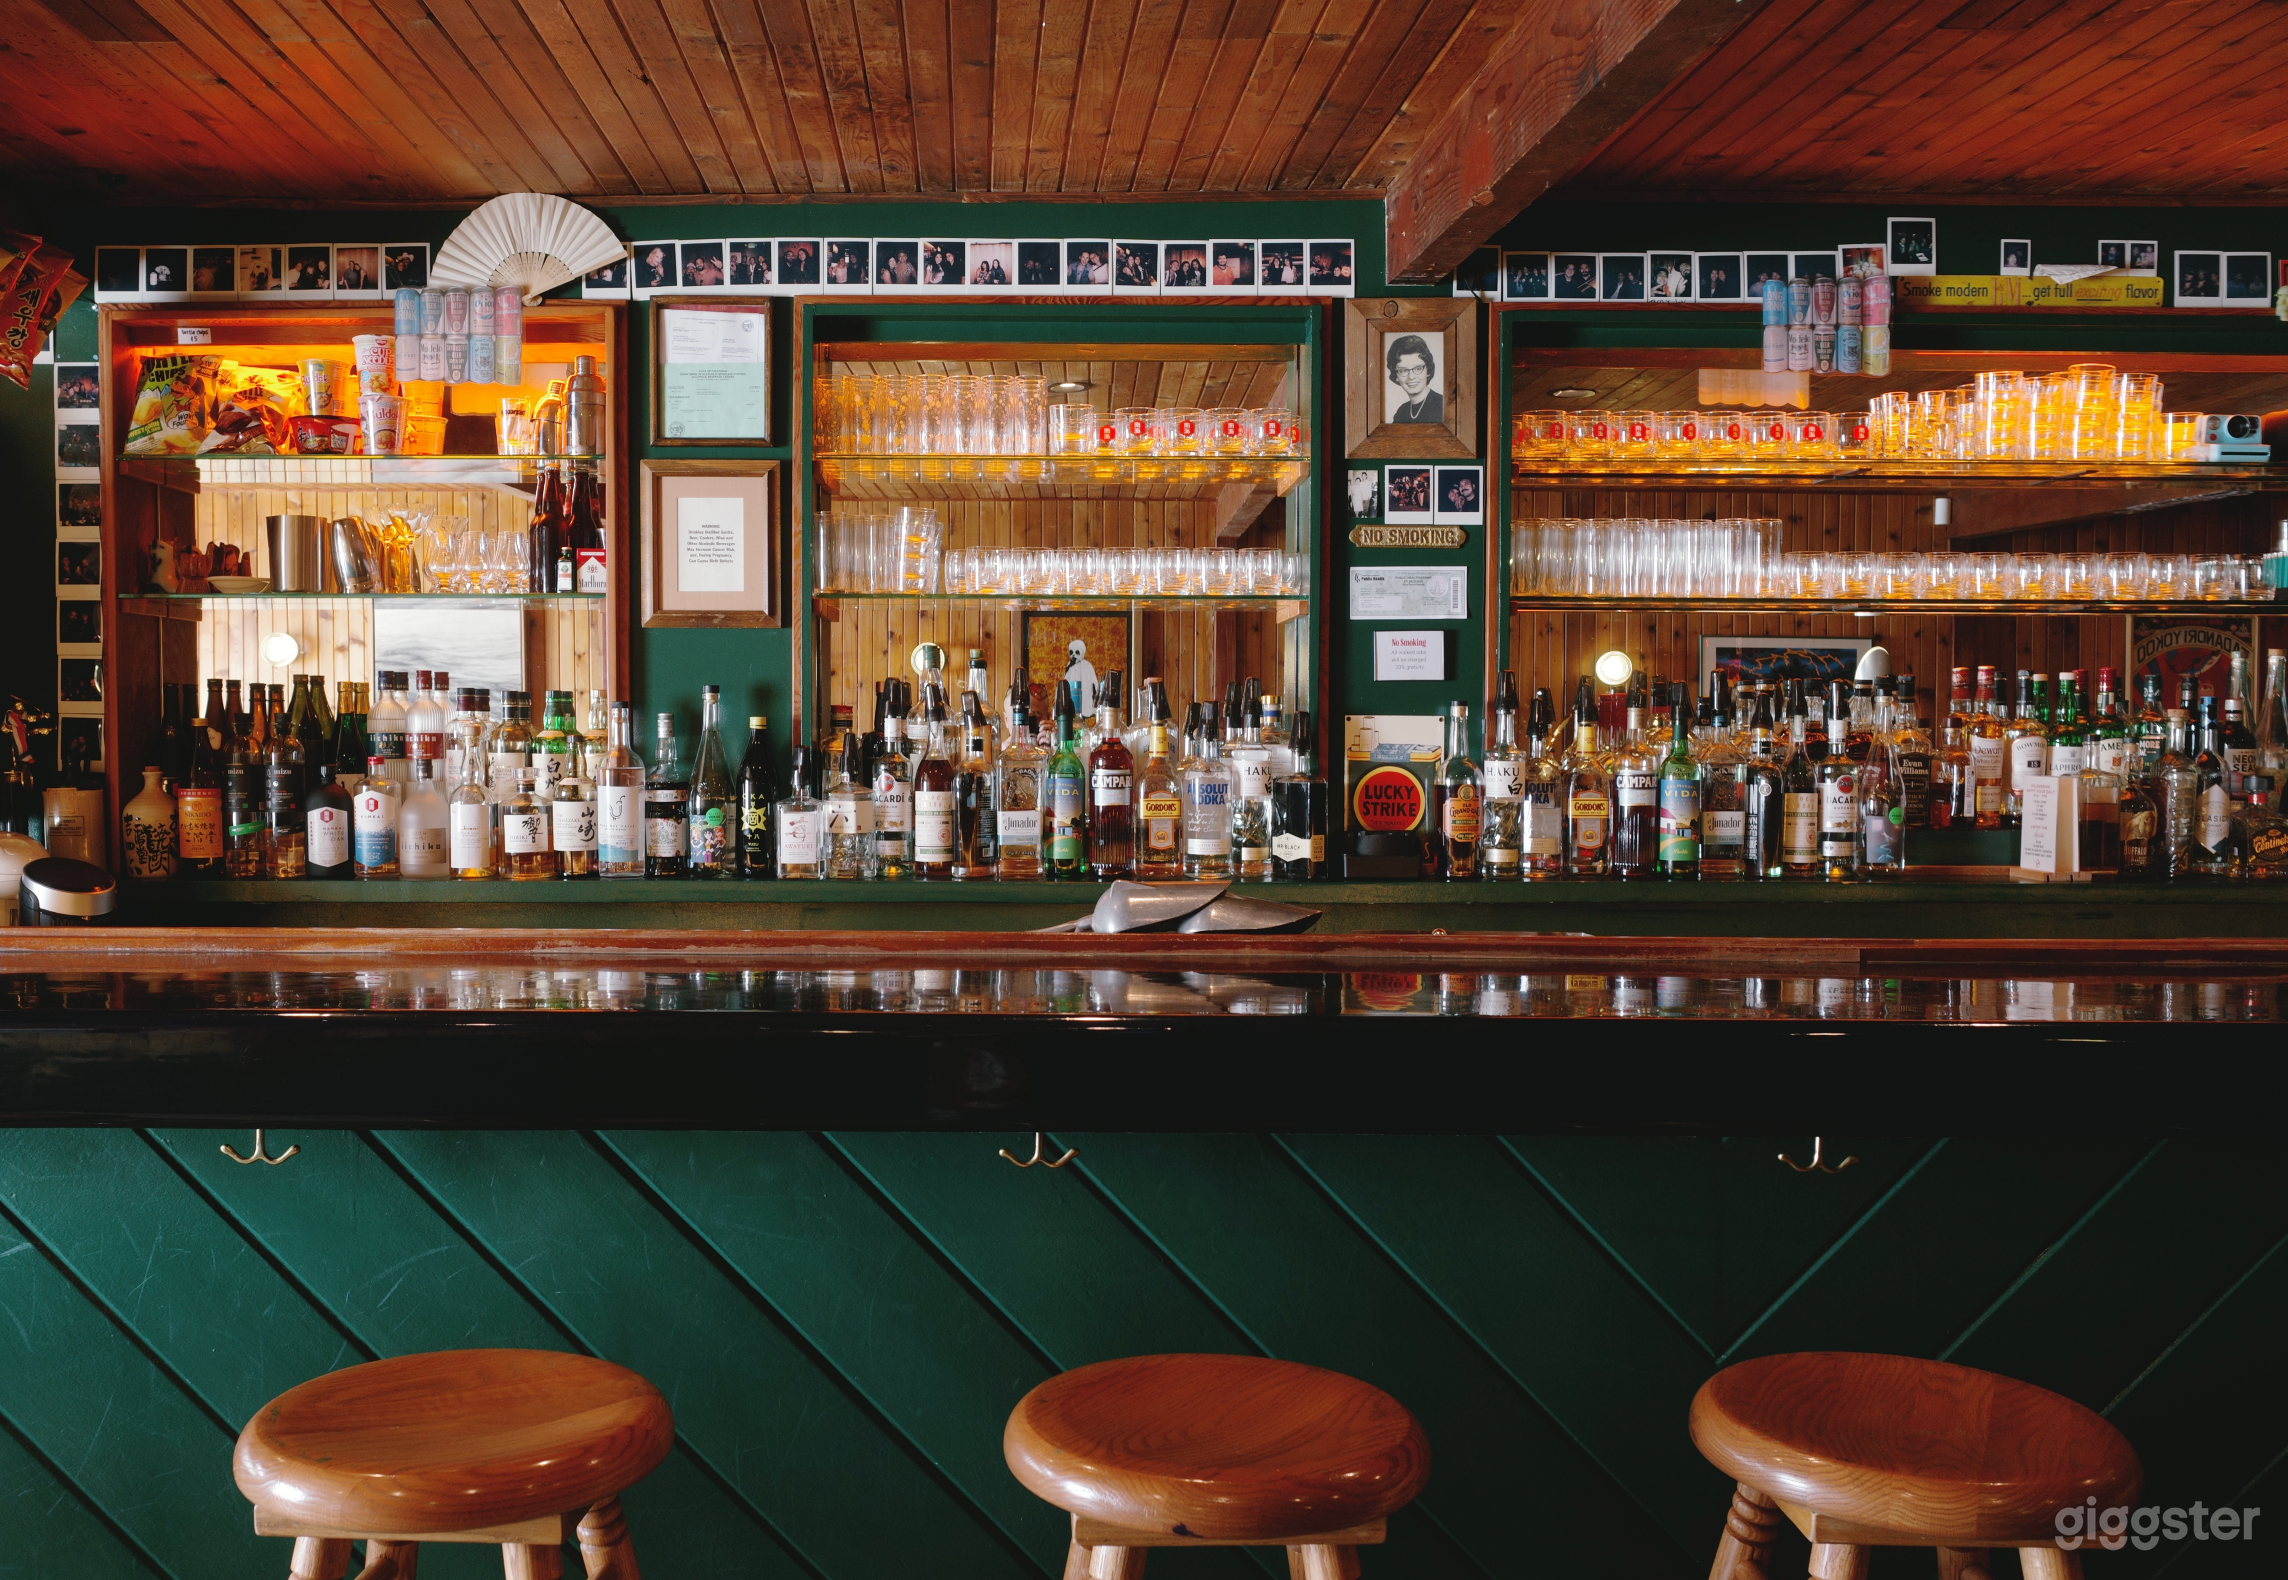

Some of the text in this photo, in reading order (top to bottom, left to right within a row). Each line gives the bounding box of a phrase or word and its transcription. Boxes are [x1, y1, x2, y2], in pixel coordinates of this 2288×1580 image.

[1903, 282, 1942, 298] Smoke
[1946, 284, 1988, 297] modern
[2033, 286, 2051, 302] get
[2054, 284, 2072, 298] full
[2076, 286, 2122, 301] exciting
[2126, 282, 2158, 298] flavor
[370, 347, 392, 356] CUP
[149, 366, 185, 382] CHIPS
[1363, 530, 1455, 545] NO SMOKING
[1400, 639, 1426, 647] Smoking
[1903, 758, 1923, 767] Evan
[545, 758, 562, 790] 白州
[1487, 767, 1519, 776] HAKU
[1616, 776, 1657, 788] CAMPAR
[1365, 785, 1414, 799] LUCKY
[1191, 795, 1225, 805] VODKA
[1828, 796, 1858, 804] ACARD
[1146, 803, 1176, 811] GORDON'S
[1363, 802, 1416, 817] STRIKE
[1575, 802, 1605, 811] GORDON'S
[1005, 816, 1038, 831] Jimador
[1709, 817, 1741, 831] Jimador
